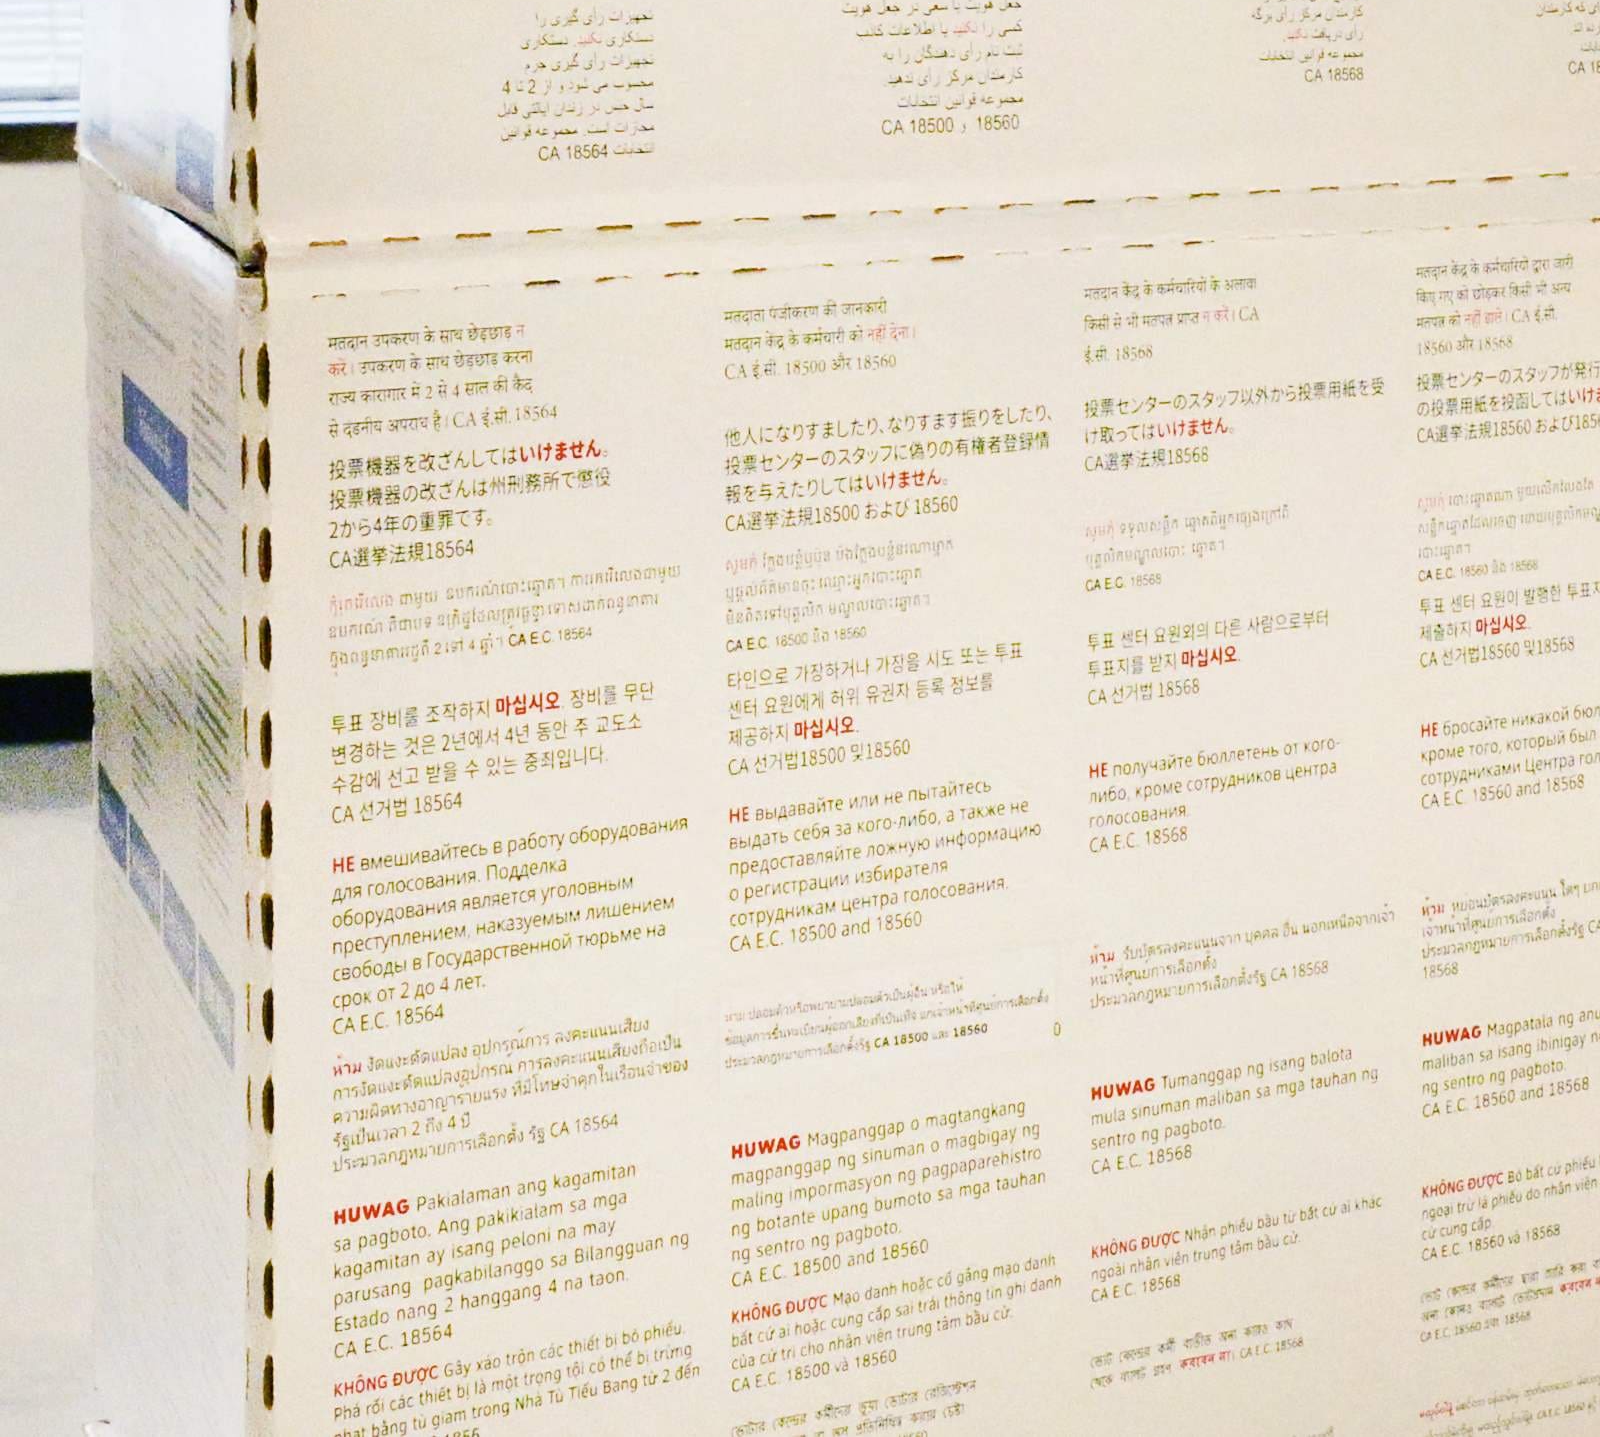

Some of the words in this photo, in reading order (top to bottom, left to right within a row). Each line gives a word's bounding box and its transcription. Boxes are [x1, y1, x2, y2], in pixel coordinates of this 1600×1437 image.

[332, 806, 354, 823] CA
[360, 798, 407, 822] 선거법
[414, 792, 462, 814] 18564
[333, 856, 354, 873] НЕ
[361, 843, 490, 873] вмешивайтесь
[493, 841, 502, 854] в
[508, 832, 564, 857] работу
[570, 818, 688, 845] оборудования
[1423, 1026, 1481, 1046] HUWAG
[1488, 1015, 1555, 1042] Magpatala
[1559, 1013, 1573, 1028] ng
[1091, 1078, 1155, 1100] HUWAG
[1161, 1067, 1241, 1092] Tumanggap
[1248, 1063, 1264, 1078] ng
[1270, 1057, 1304, 1072] isang
[1311, 1049, 1352, 1065] balota
[334, 1199, 409, 1225] HUWAG
[417, 1186, 512, 1214] Pakialaman
[518, 1180, 547, 1196] ang
[553, 1165, 635, 1194] kagamitan
